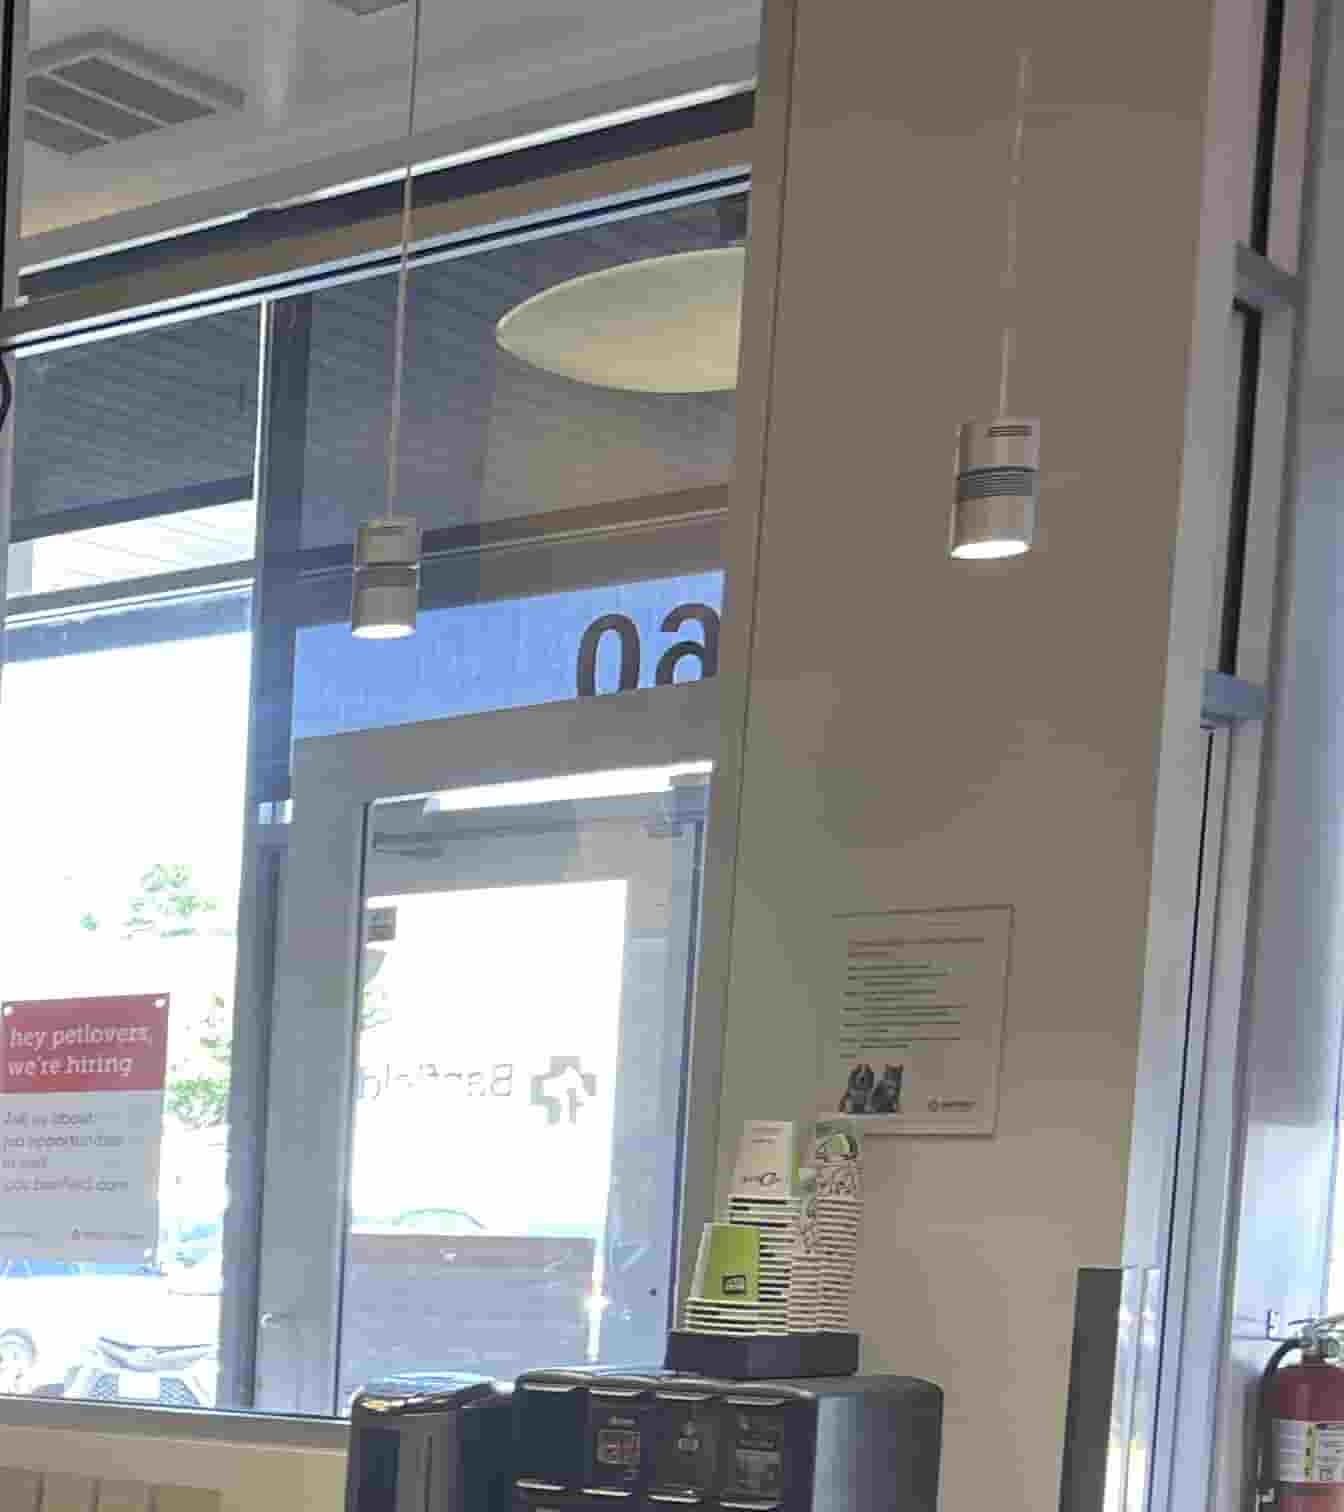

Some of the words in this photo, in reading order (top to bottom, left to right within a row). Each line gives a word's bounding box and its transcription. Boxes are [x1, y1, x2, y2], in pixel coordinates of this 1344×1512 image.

[9, 1026, 48, 1051] hey
[7, 1056, 61, 1076] we're
[65, 1055, 134, 1077] hiring
